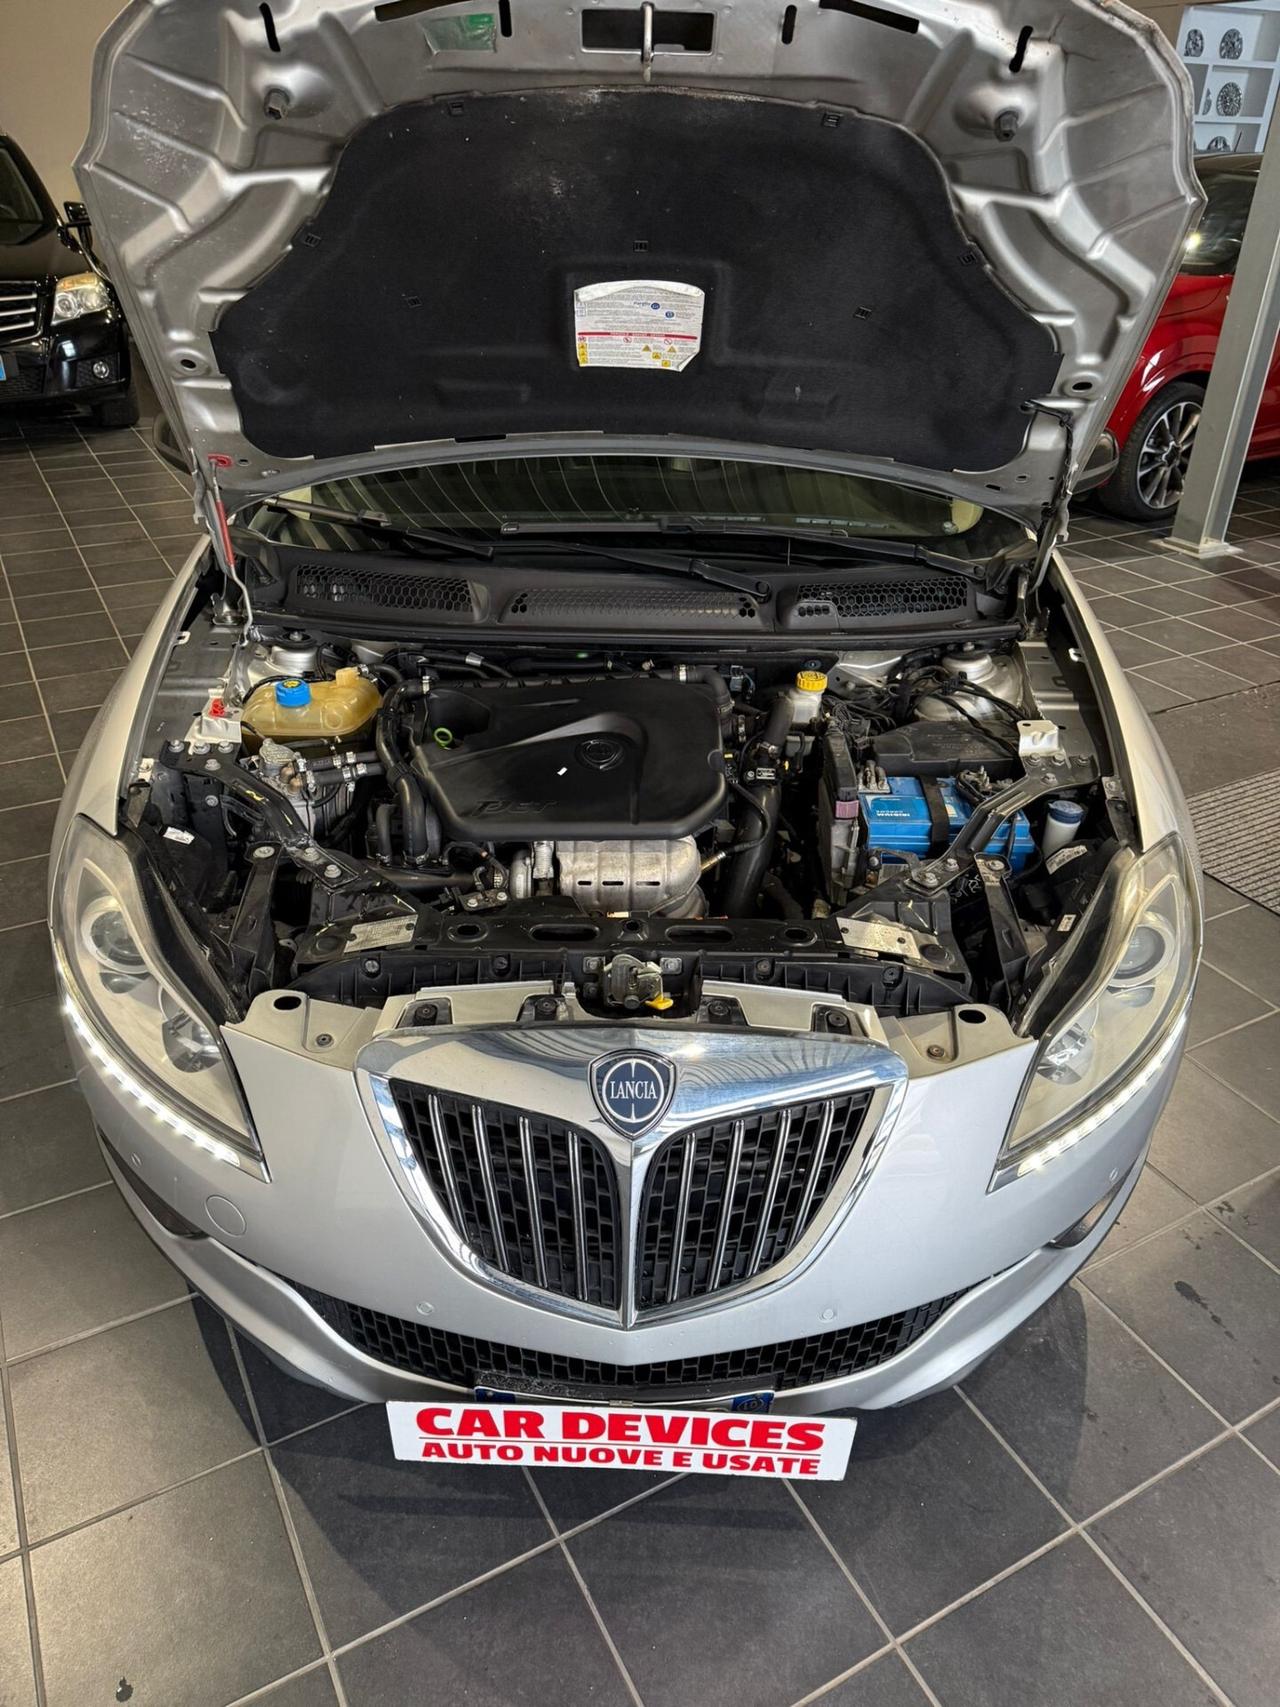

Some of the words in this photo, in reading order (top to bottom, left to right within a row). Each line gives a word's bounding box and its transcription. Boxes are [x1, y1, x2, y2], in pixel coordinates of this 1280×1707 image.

[610, 1081, 658, 1099] LANCIA
[415, 1407, 545, 1440] CAR
[561, 1410, 825, 1453] DEVICES
[421, 1441, 525, 1462] AUTO
[532, 1446, 663, 1467] NUOVE
[671, 1451, 692, 1469] E
[701, 1453, 820, 1476] USATE
